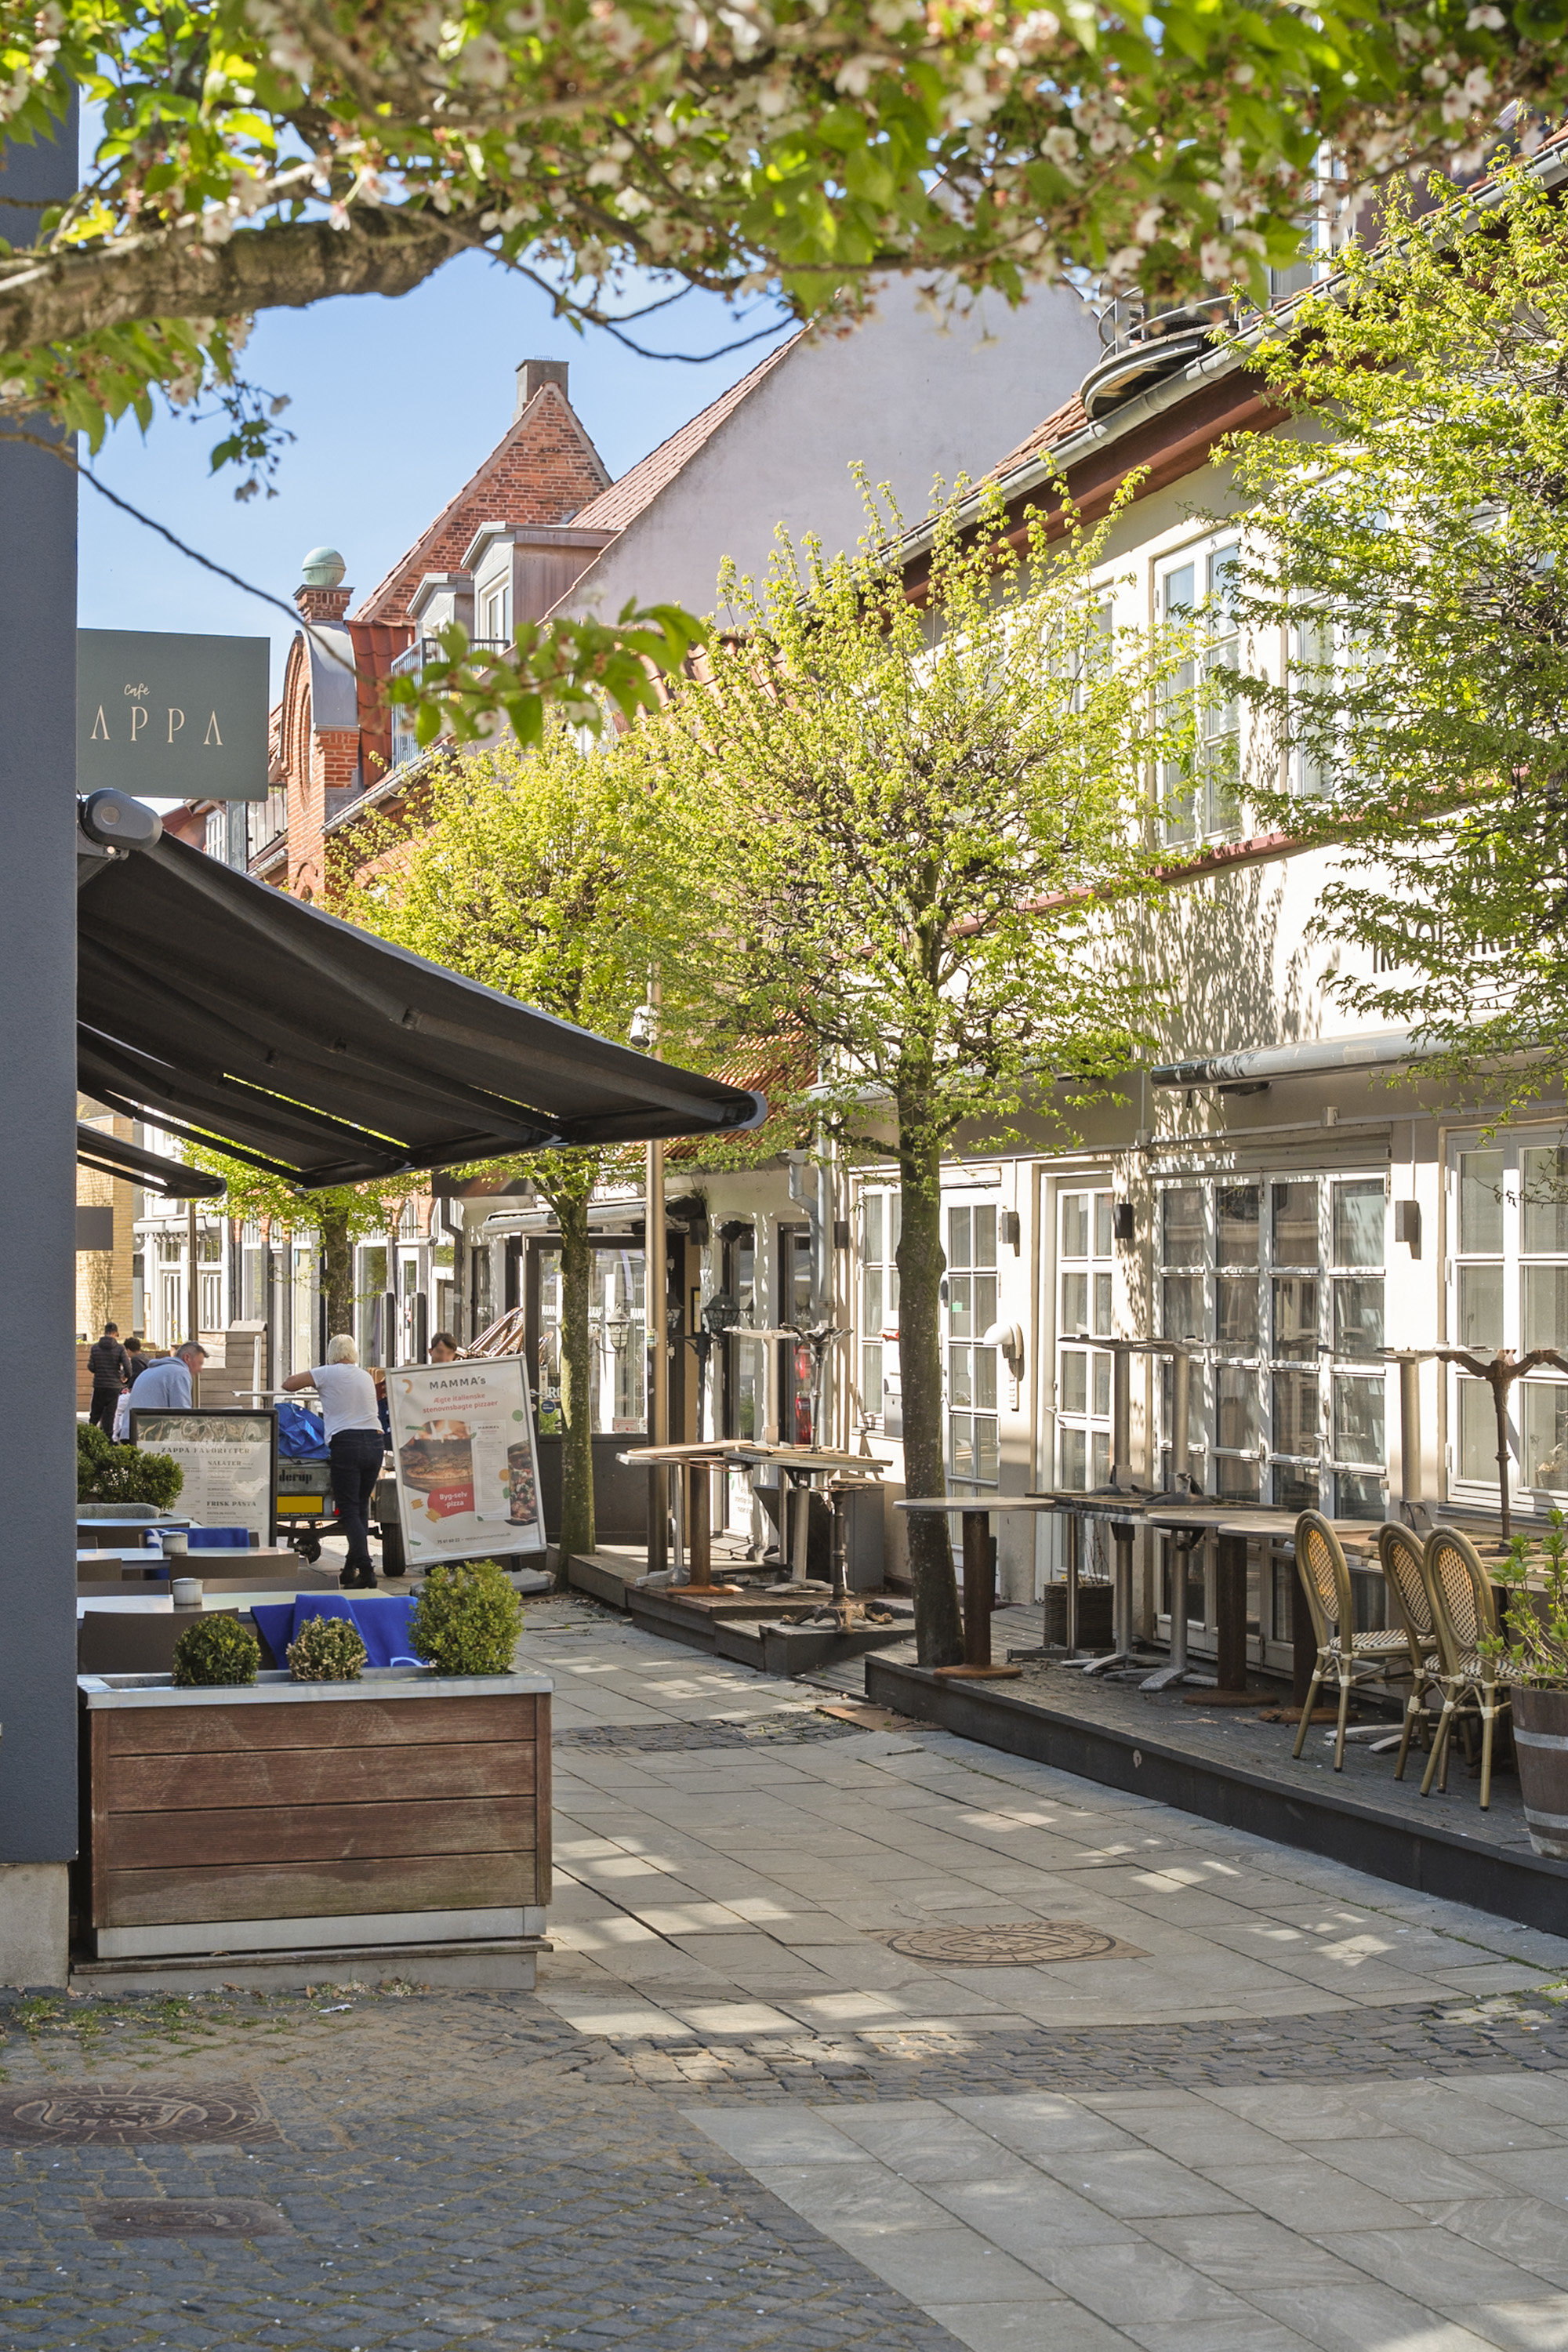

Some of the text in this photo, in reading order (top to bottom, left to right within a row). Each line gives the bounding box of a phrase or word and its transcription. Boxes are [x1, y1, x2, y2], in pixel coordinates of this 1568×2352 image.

[430, 1376, 486, 1389] MAMMA's
[423, 1400, 498, 1414] stenovnsbagte pizzaer
[439, 1491, 468, 1501] Byg-selv
